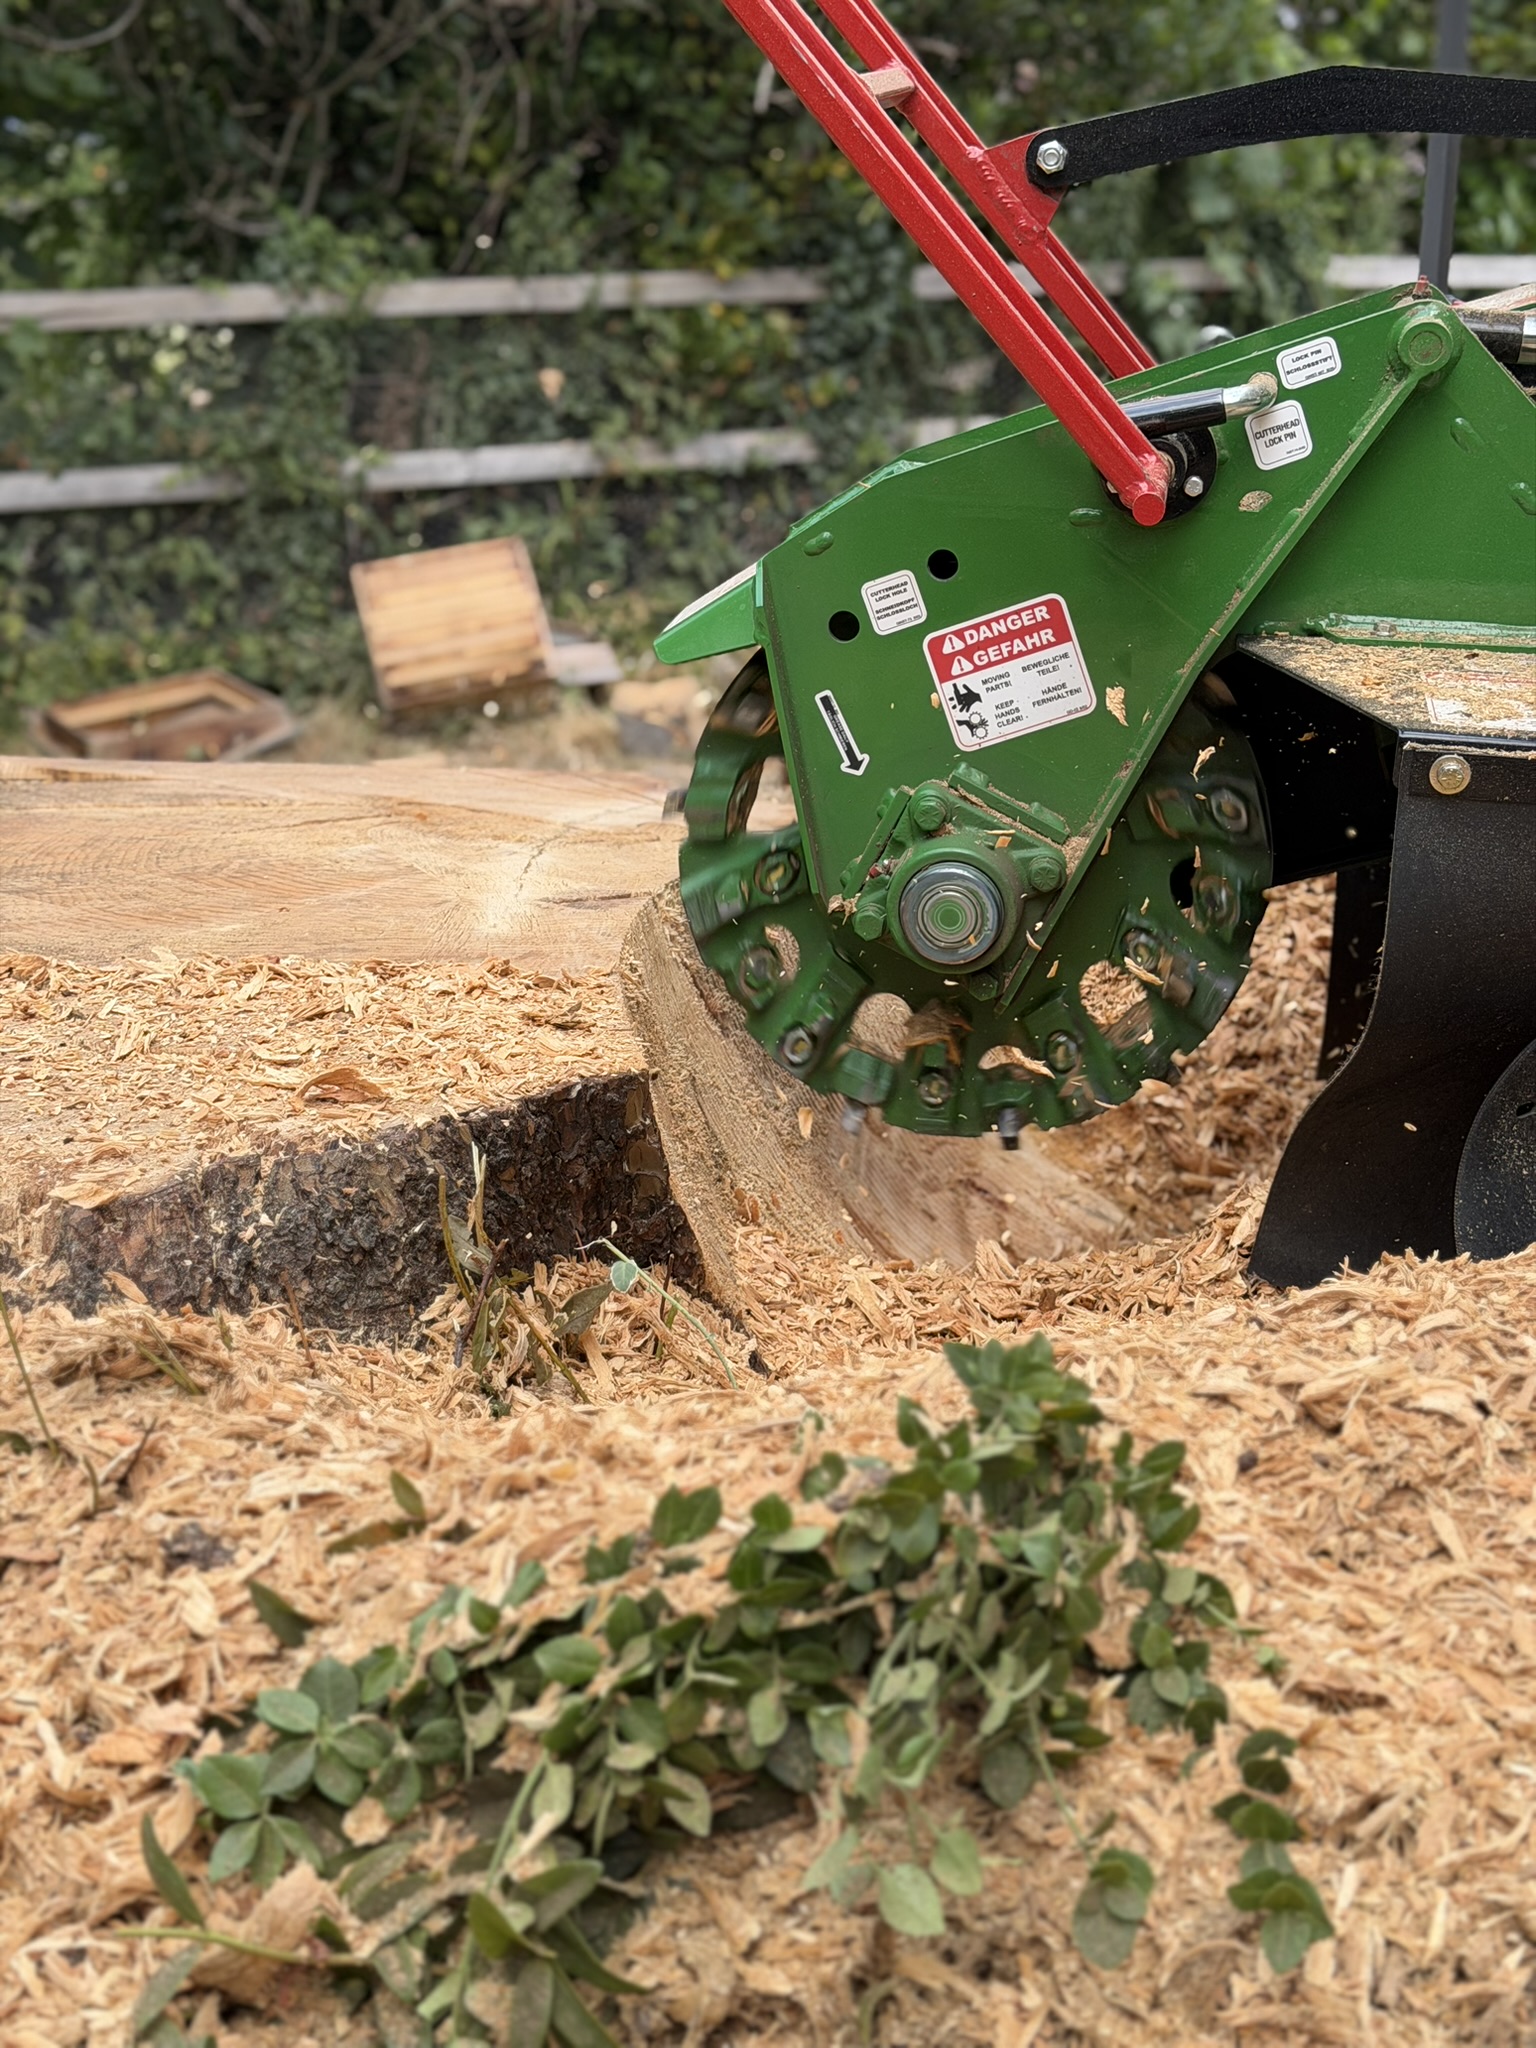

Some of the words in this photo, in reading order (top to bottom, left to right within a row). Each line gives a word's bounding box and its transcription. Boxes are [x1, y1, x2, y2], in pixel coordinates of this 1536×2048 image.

[1292, 353, 1309, 363] LOCK
[1255, 419, 1300, 440] CUTTERHEAD
[1264, 435, 1283, 448] LOCK
[1284, 431, 1297, 442] PIN
[870, 581, 908, 597] CUTTERHEAD
[875, 594, 891, 602] LOCK
[891, 588, 908, 597] HOLE
[963, 605, 1051, 646] DANGER
[973, 628, 1056, 666] GEFAHR
[1021, 652, 1070, 673] BEWEGLICHE
[1036, 664, 1060, 677] TEILE!
[981, 671, 1011, 686] MOVING
[985, 680, 1012, 693] PARTS!
[994, 699, 1014, 711] KEEP
[994, 706, 1020, 720] HANDS
[996, 714, 1024, 729] CLEAR!
